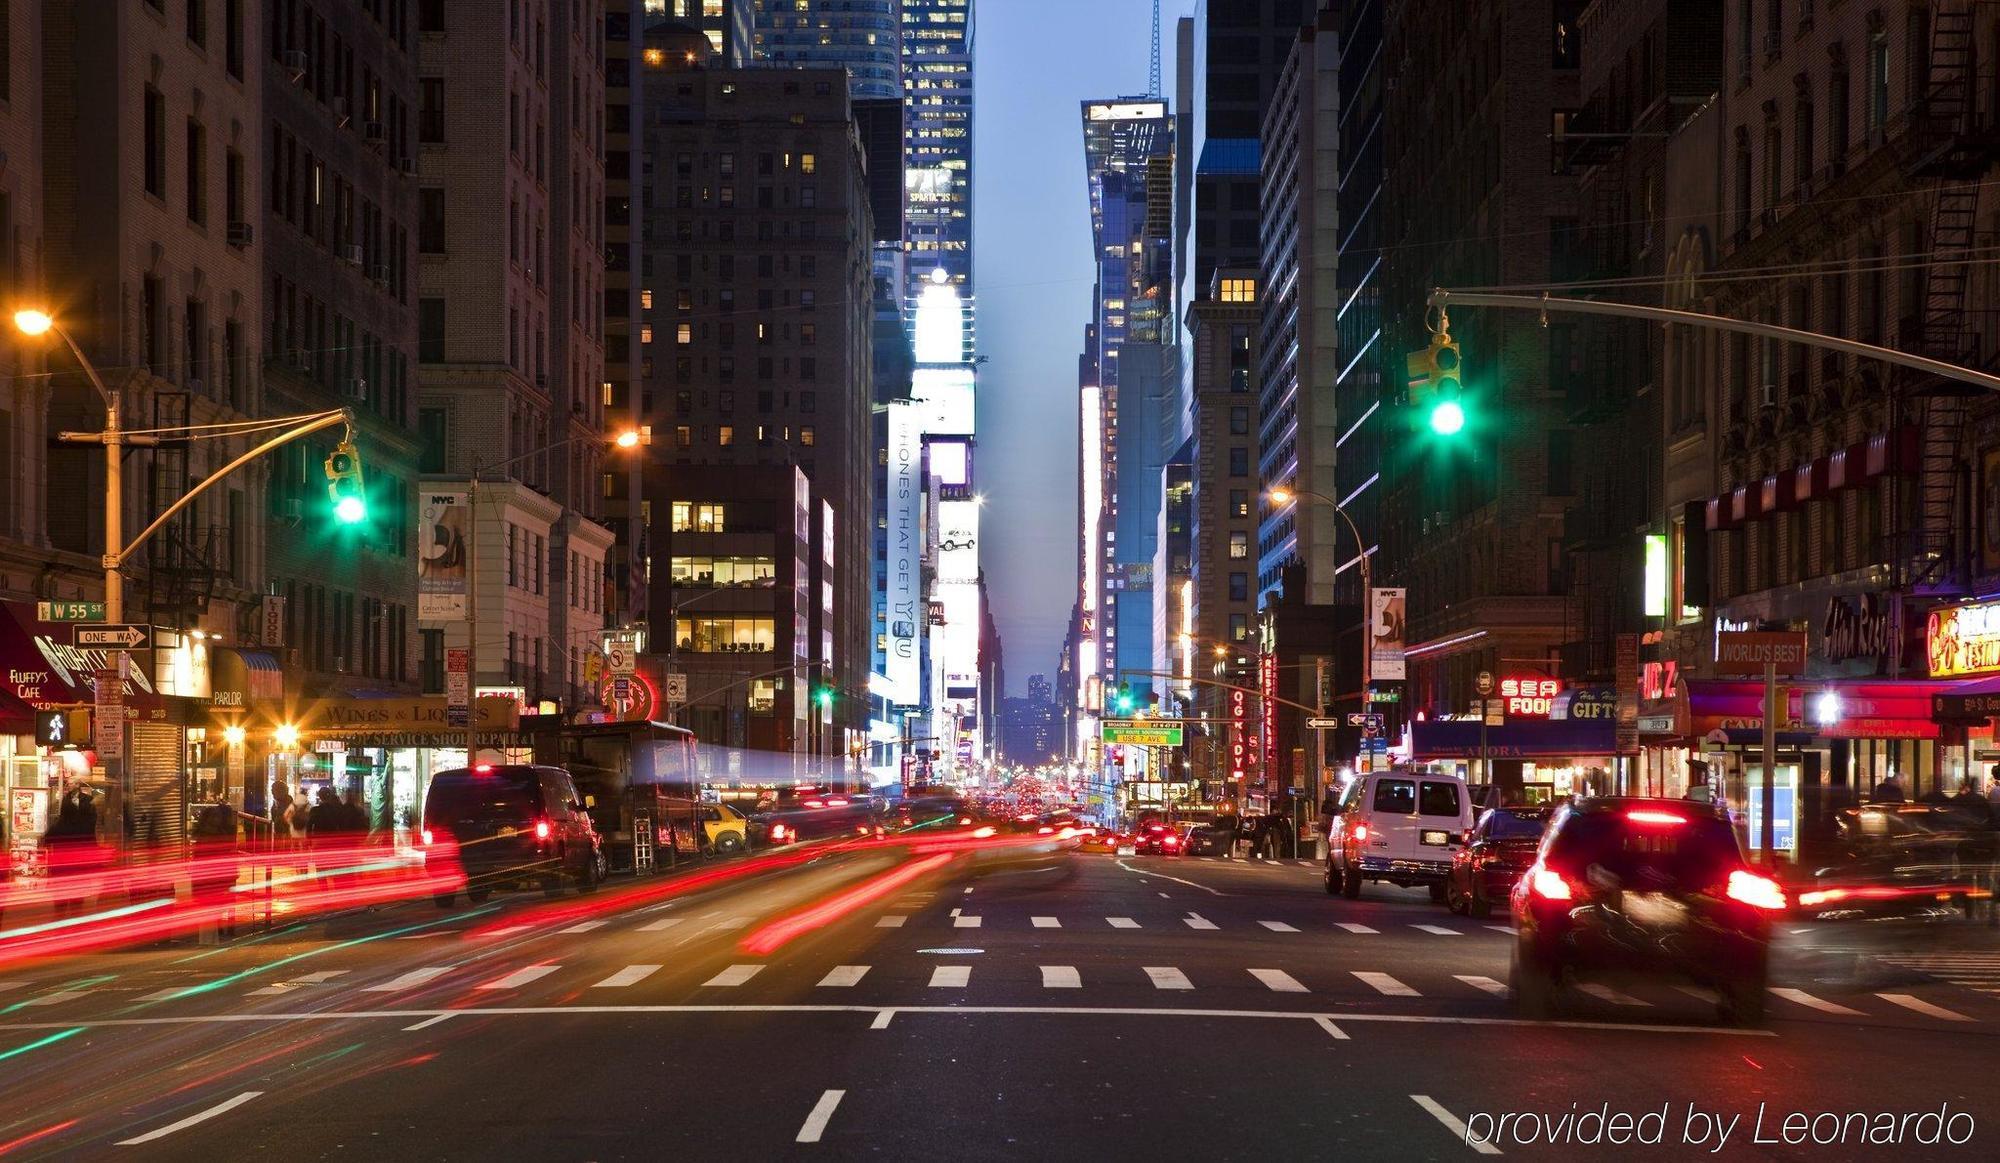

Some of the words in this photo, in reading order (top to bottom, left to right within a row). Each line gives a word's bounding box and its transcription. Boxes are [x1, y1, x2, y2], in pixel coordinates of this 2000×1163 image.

[432, 496, 454, 504] NYC
[898, 506, 910, 546] THAT
[899, 562, 910, 594] GET
[54, 605, 65, 618] W
[69, 604, 87, 619] 55
[91, 604, 102, 612] ST
[85, 632, 107, 642] ONE
[117, 632, 139, 642] WAY
[1723, 644, 1772, 662] WORLD'S
[1775, 644, 1801, 662] BEST
[9, 669, 49, 684] FLUFFY'S
[18, 684, 41, 699] CAFE
[1501, 679, 1558, 697] SEA
[214, 691, 242, 706] PARLOR
[1382, 693, 1392, 701] 54
[326, 706, 389, 722] WINES
[395, 712, 407, 722] &
[374, 732, 428, 746] SERVICE
[476, 731, 519, 746] REPAIR
